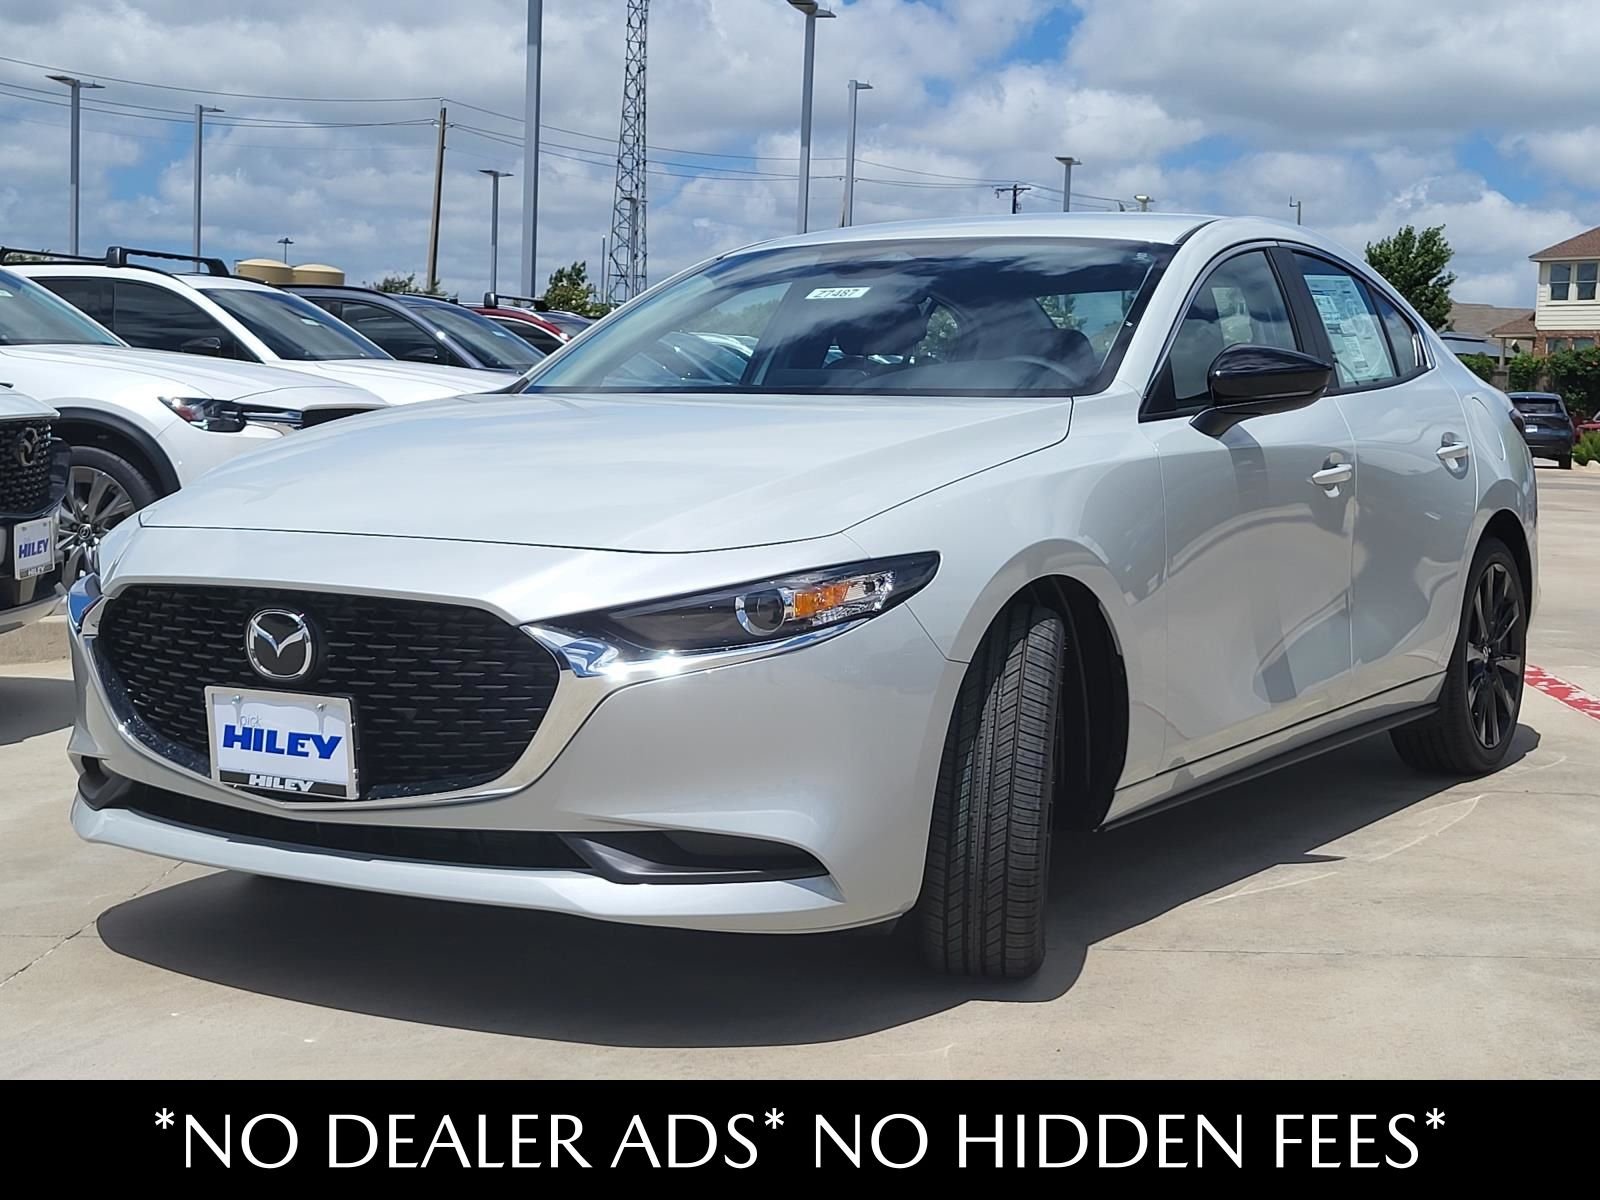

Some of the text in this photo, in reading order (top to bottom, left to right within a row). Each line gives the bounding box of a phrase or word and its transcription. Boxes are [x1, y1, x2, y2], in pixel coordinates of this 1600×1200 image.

[18, 537, 49, 559] HILEY
[222, 724, 343, 760] HILEY
[248, 774, 315, 792] HILEY
